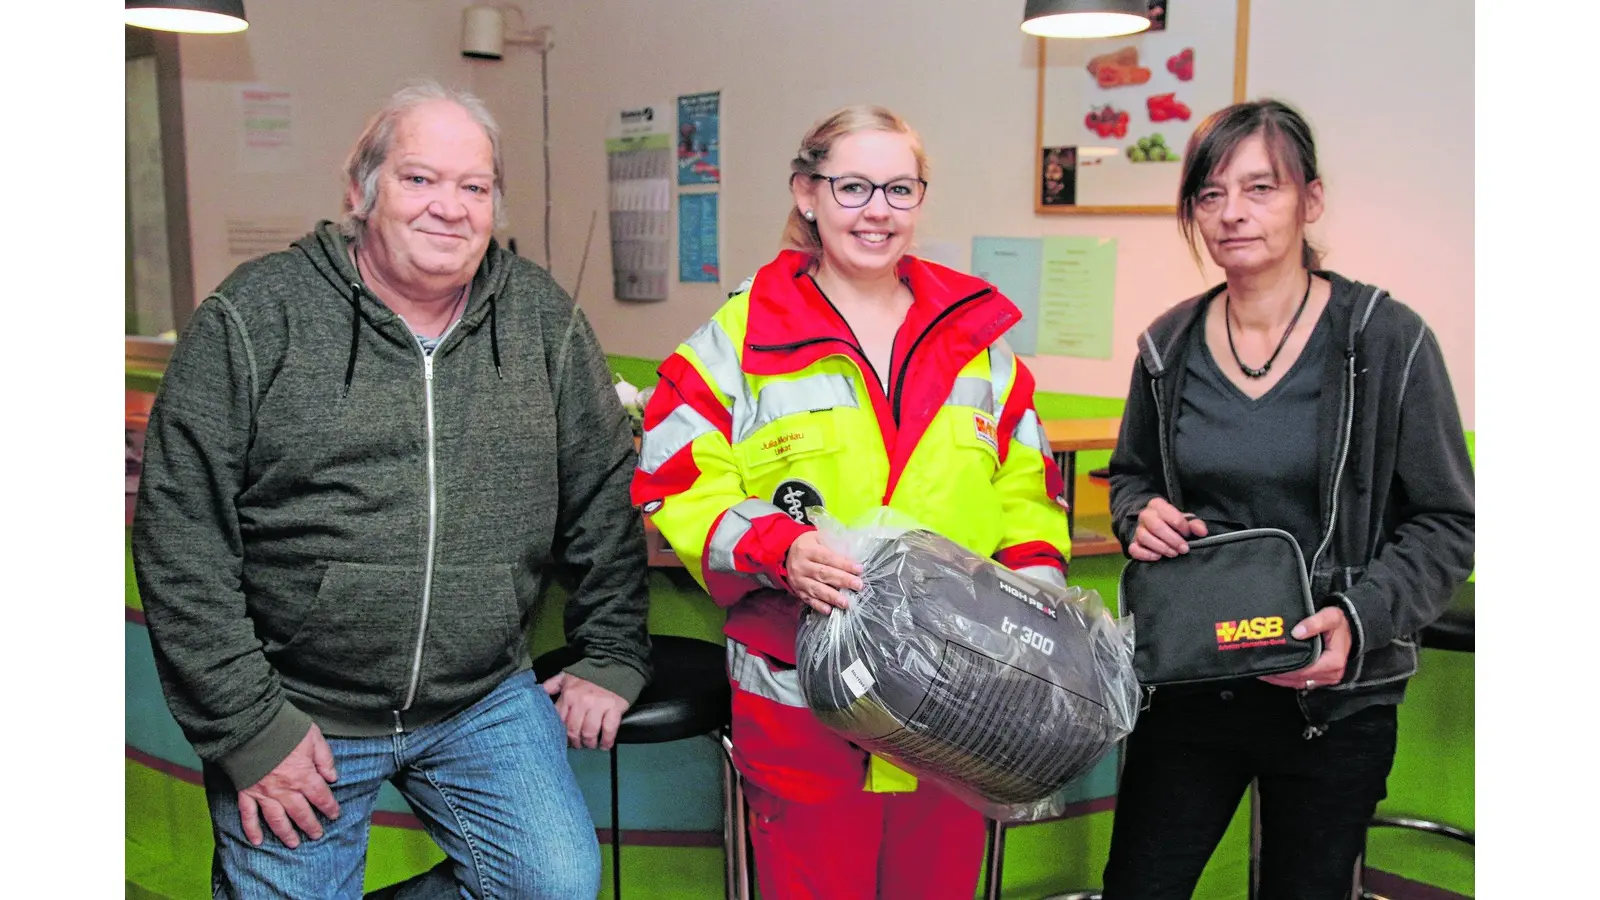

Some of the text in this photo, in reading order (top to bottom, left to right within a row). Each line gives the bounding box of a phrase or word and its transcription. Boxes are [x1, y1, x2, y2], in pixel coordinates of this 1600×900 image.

[1000, 581, 1057, 619] HIGH PEAK
[1001, 616, 1055, 656] tr 300
[1233, 616, 1284, 641] ASB
